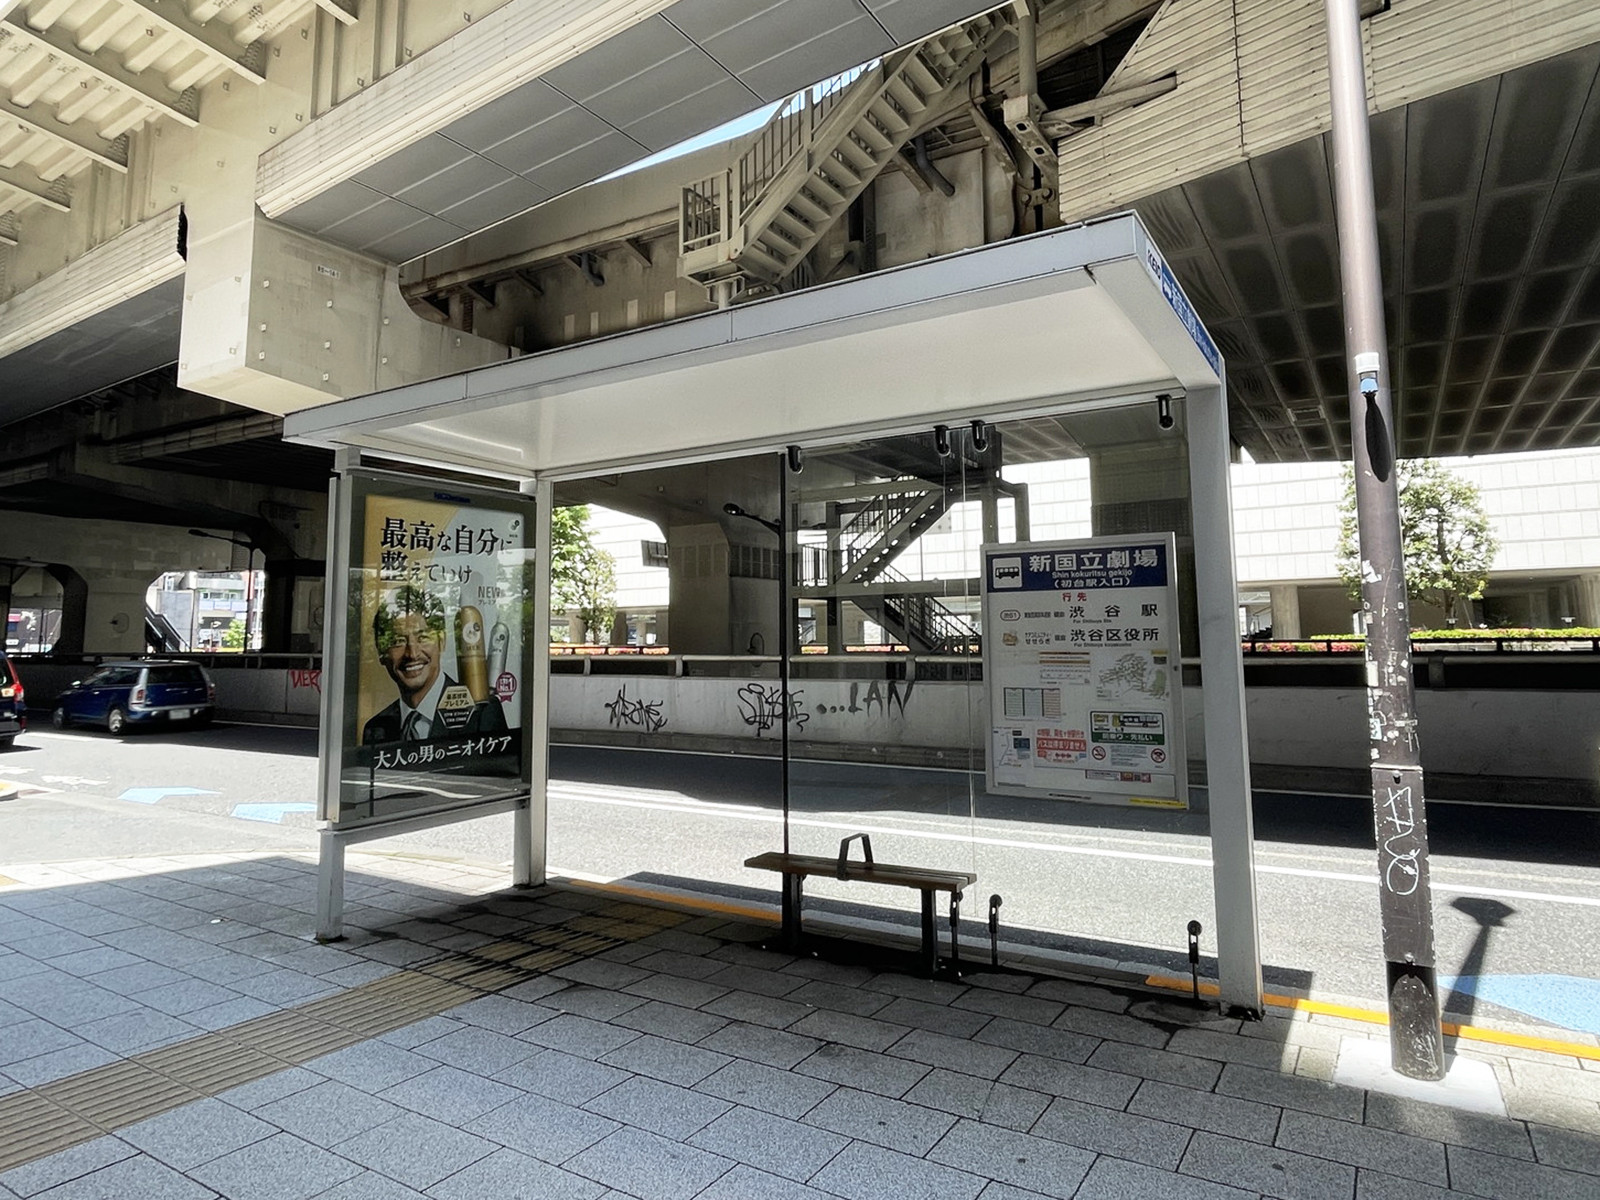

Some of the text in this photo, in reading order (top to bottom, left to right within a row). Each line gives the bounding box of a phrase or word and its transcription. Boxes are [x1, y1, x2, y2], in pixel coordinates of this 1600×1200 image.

[381, 517, 513, 556] 最高な自分に
[381, 550, 473, 584] 整えていけ
[1029, 548, 1159, 573] 新国立劇場
[1051, 568, 1133, 579] Shin kokuritsu gekijo
[1070, 628, 1159, 643] 渋谷区役所
[374, 735, 512, 770] 大人の男のニオイケア
